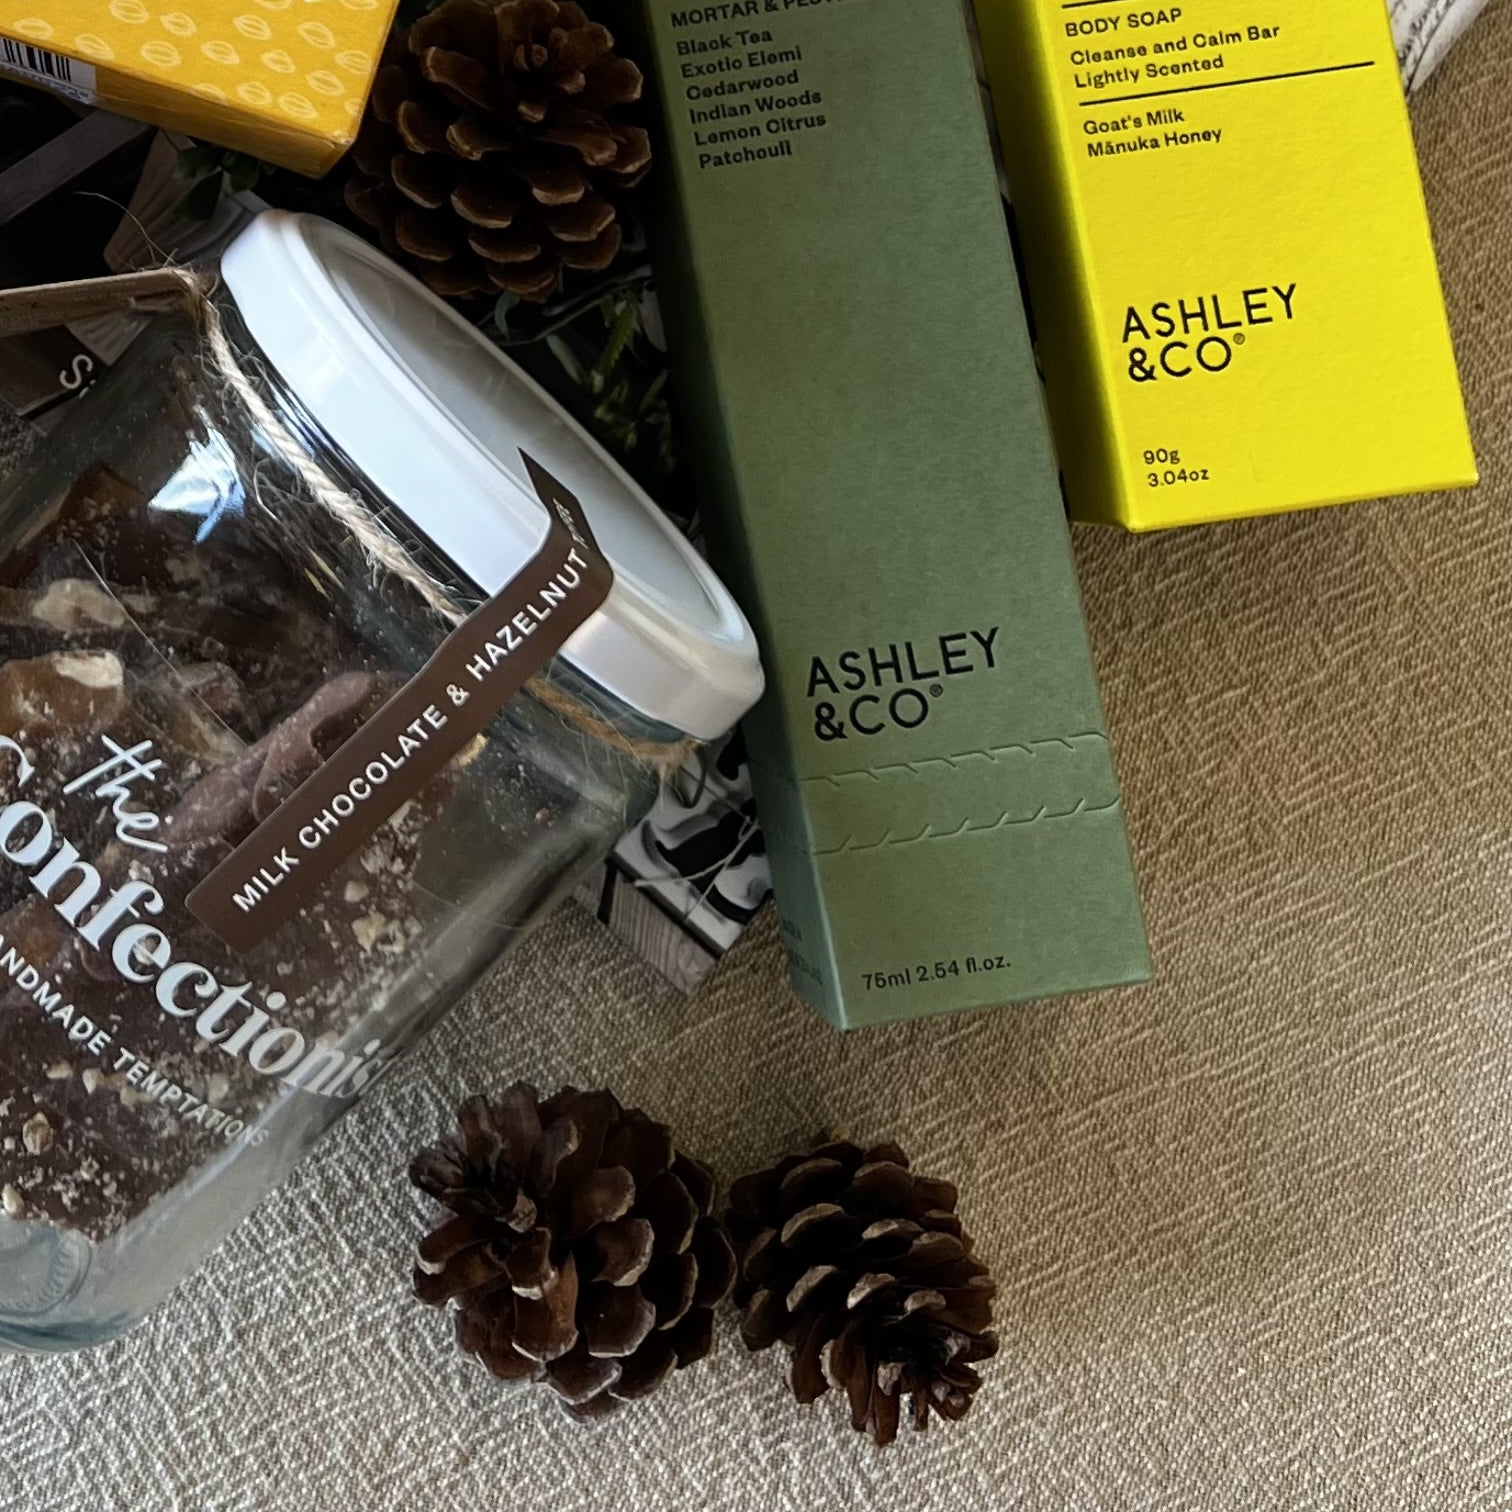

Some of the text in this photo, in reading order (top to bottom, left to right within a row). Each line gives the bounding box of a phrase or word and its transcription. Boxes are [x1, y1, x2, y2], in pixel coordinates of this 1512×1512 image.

[671, 0, 759, 27] MORTAR
[1065, 8, 1182, 38] BODY SOAP
[677, 27, 773, 56] Black Tea
[1070, 23, 1280, 66] Cleanse and Calm Bar
[681, 46, 802, 79] Exotic Elemi
[1075, 54, 1224, 89] Lightly Scented
[686, 70, 799, 100] Cedarwood
[690, 90, 822, 124] Indian Woods
[1083, 108, 1185, 136] Goat's Milk
[694, 112, 826, 146] Lemon Citrus
[1165, 127, 1222, 151] Honey
[699, 141, 792, 169] Patchouli
[1122, 281, 1297, 344] ASHLEY
[1144, 448, 1180, 466] 90g
[1147, 467, 1210, 488] 3.04oz
[806, 627, 999, 696] ASHLEY
[232, 547, 589, 913] MILK CHOCOLATE & HAZELNUT
[63, 733, 167, 852] the
[862, 967, 910, 990] 75ml
[916, 959, 959, 983] 2.54
[112, 1046, 270, 1147] TEMPTATIONS
